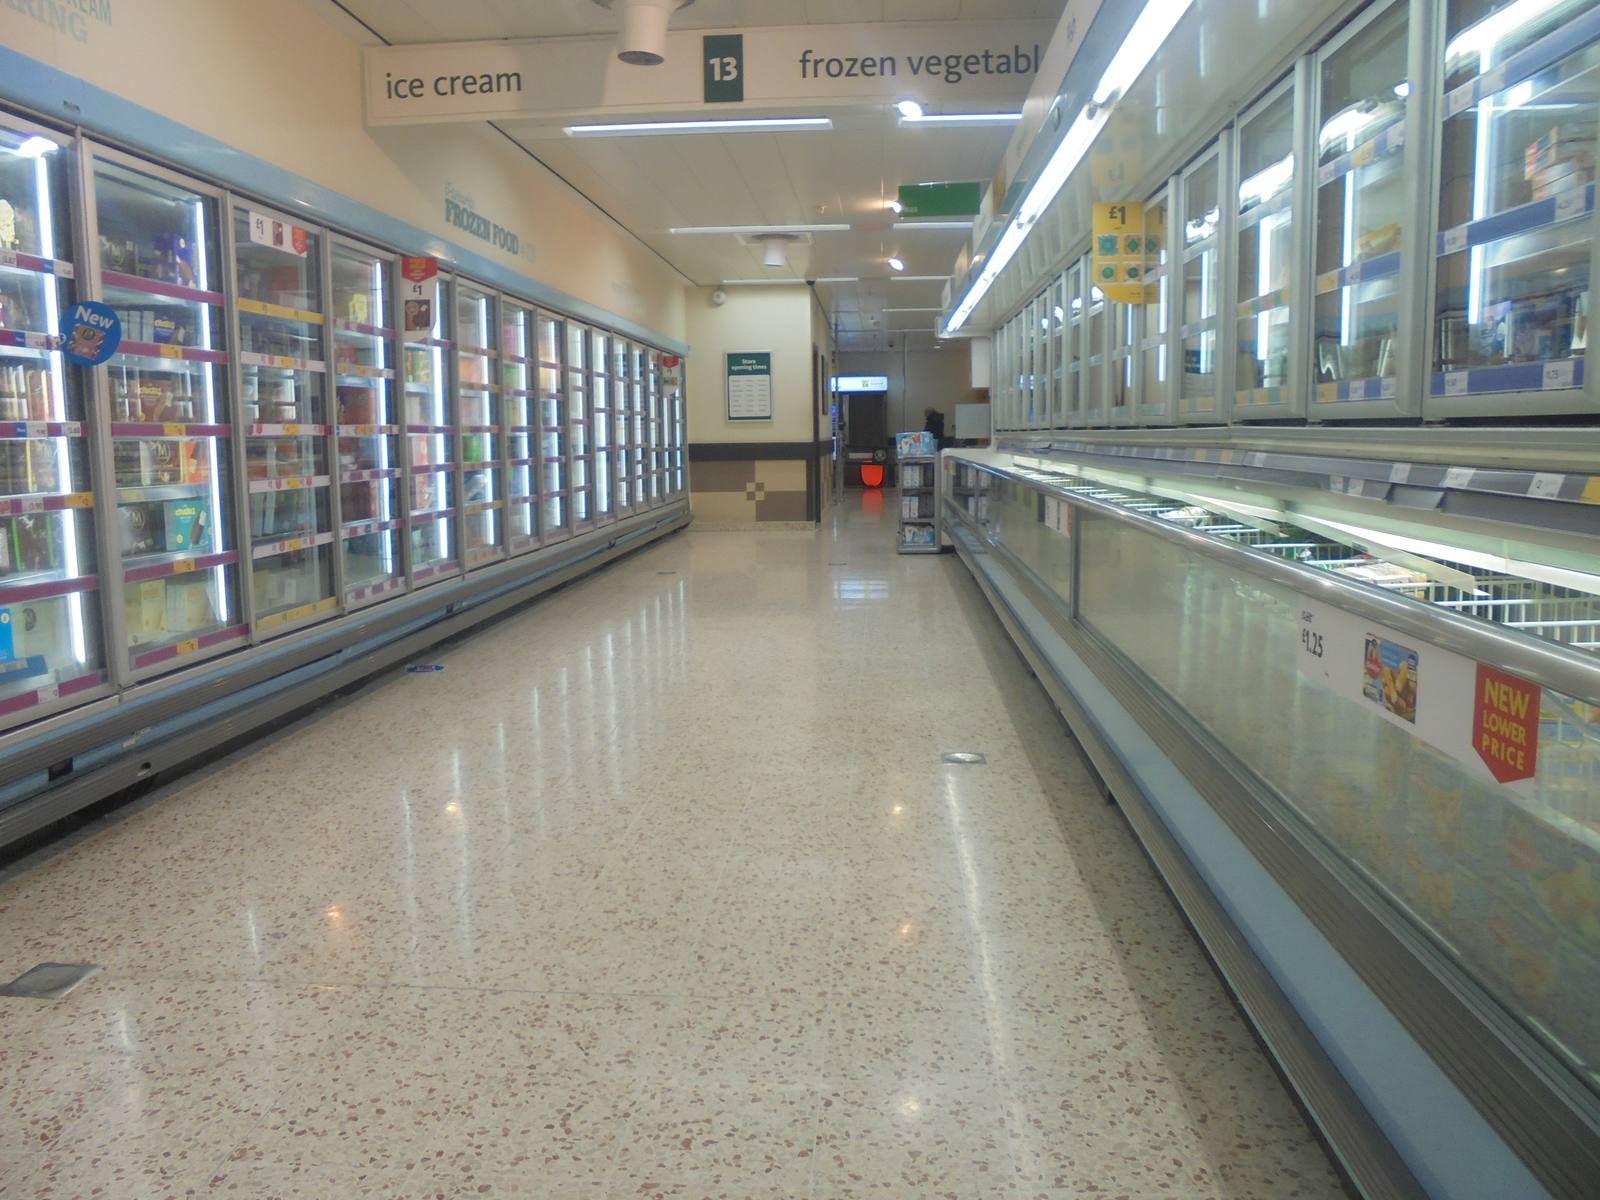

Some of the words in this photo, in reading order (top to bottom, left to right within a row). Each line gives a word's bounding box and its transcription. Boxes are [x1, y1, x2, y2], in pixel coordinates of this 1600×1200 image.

[709, 56, 738, 81] 13
[799, 49, 896, 78] frozen
[907, 44, 1039, 84] vegetabl
[386, 72, 424, 99] ice
[433, 72, 522, 96] cream
[445, 198, 490, 244] FROZEN
[492, 222, 520, 256] FOOD
[1108, 205, 1126, 225] £1
[413, 284, 422, 296] £1
[74, 304, 114, 329] New
[1302, 628, 1323, 658] £1.25
[1484, 678, 1530, 720] NEW
[1483, 709, 1526, 747] LOWER
[1482, 733, 1524, 772] PRICE
